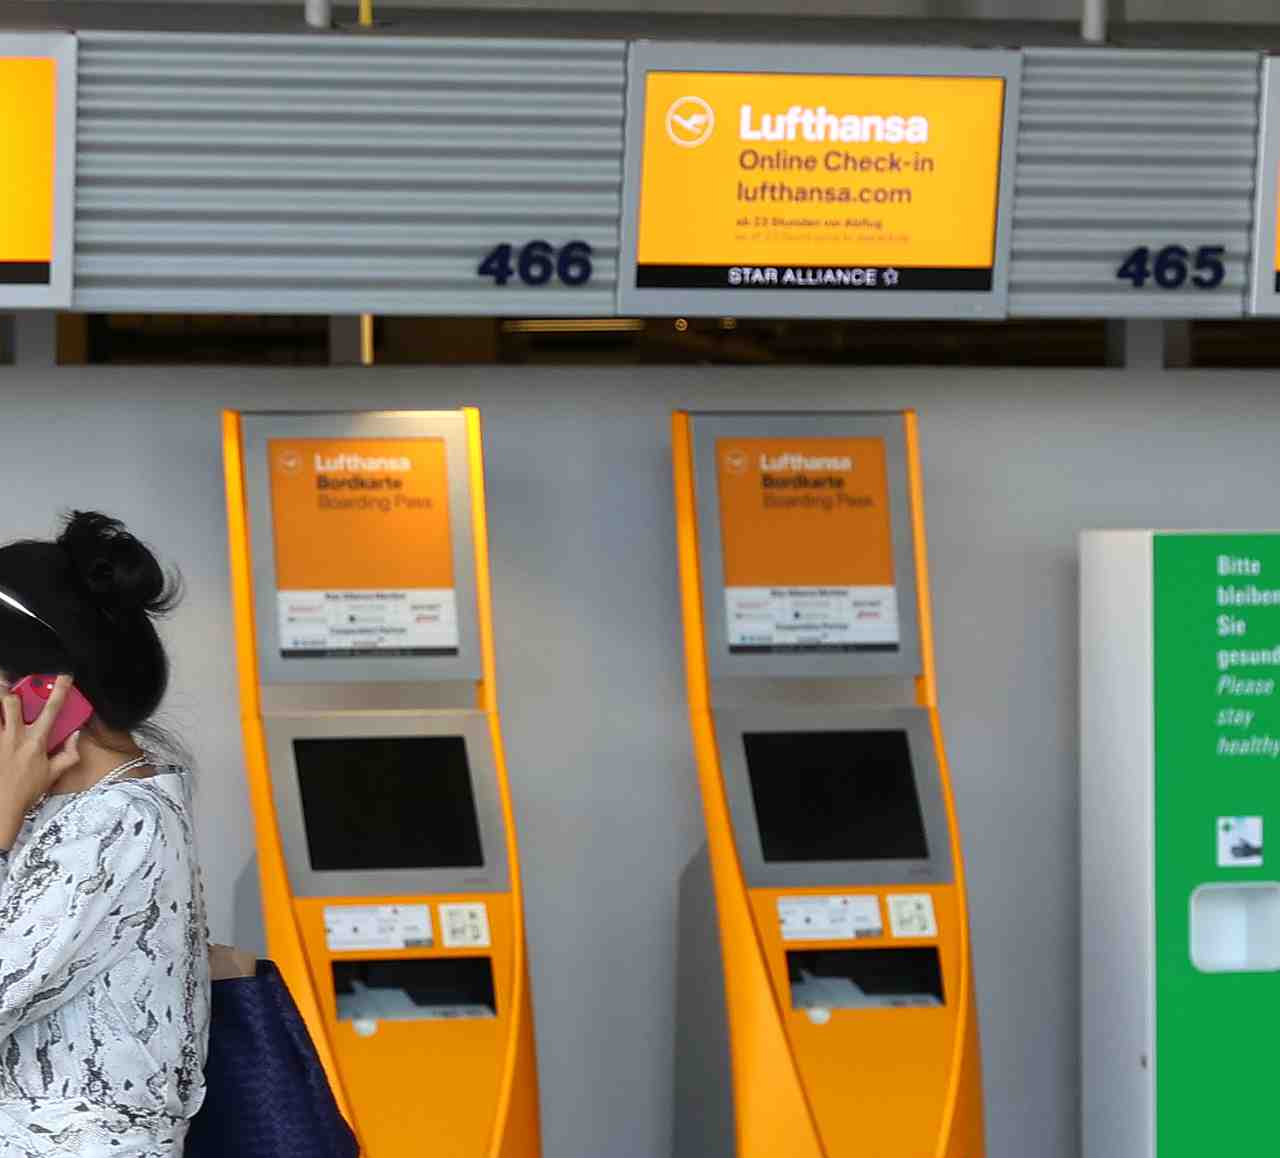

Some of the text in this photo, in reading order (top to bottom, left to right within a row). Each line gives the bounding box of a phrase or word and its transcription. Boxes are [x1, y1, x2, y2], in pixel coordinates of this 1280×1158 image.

[739, 104, 929, 144] Lufthansa
[738, 149, 935, 173] Online Check-in
[737, 181, 913, 205] lufthansa.com
[477, 240, 594, 287] 466
[1116, 245, 1227, 290] 465
[728, 268, 877, 287] STAR ALLIANCE
[314, 453, 412, 472] Lufthansa
[760, 453, 852, 471] Lufthansa
[1216, 555, 1261, 576] Bitte
[1216, 614, 1246, 636] Sie
[1216, 675, 1275, 696] Please
[1216, 708, 1254, 729] stay
